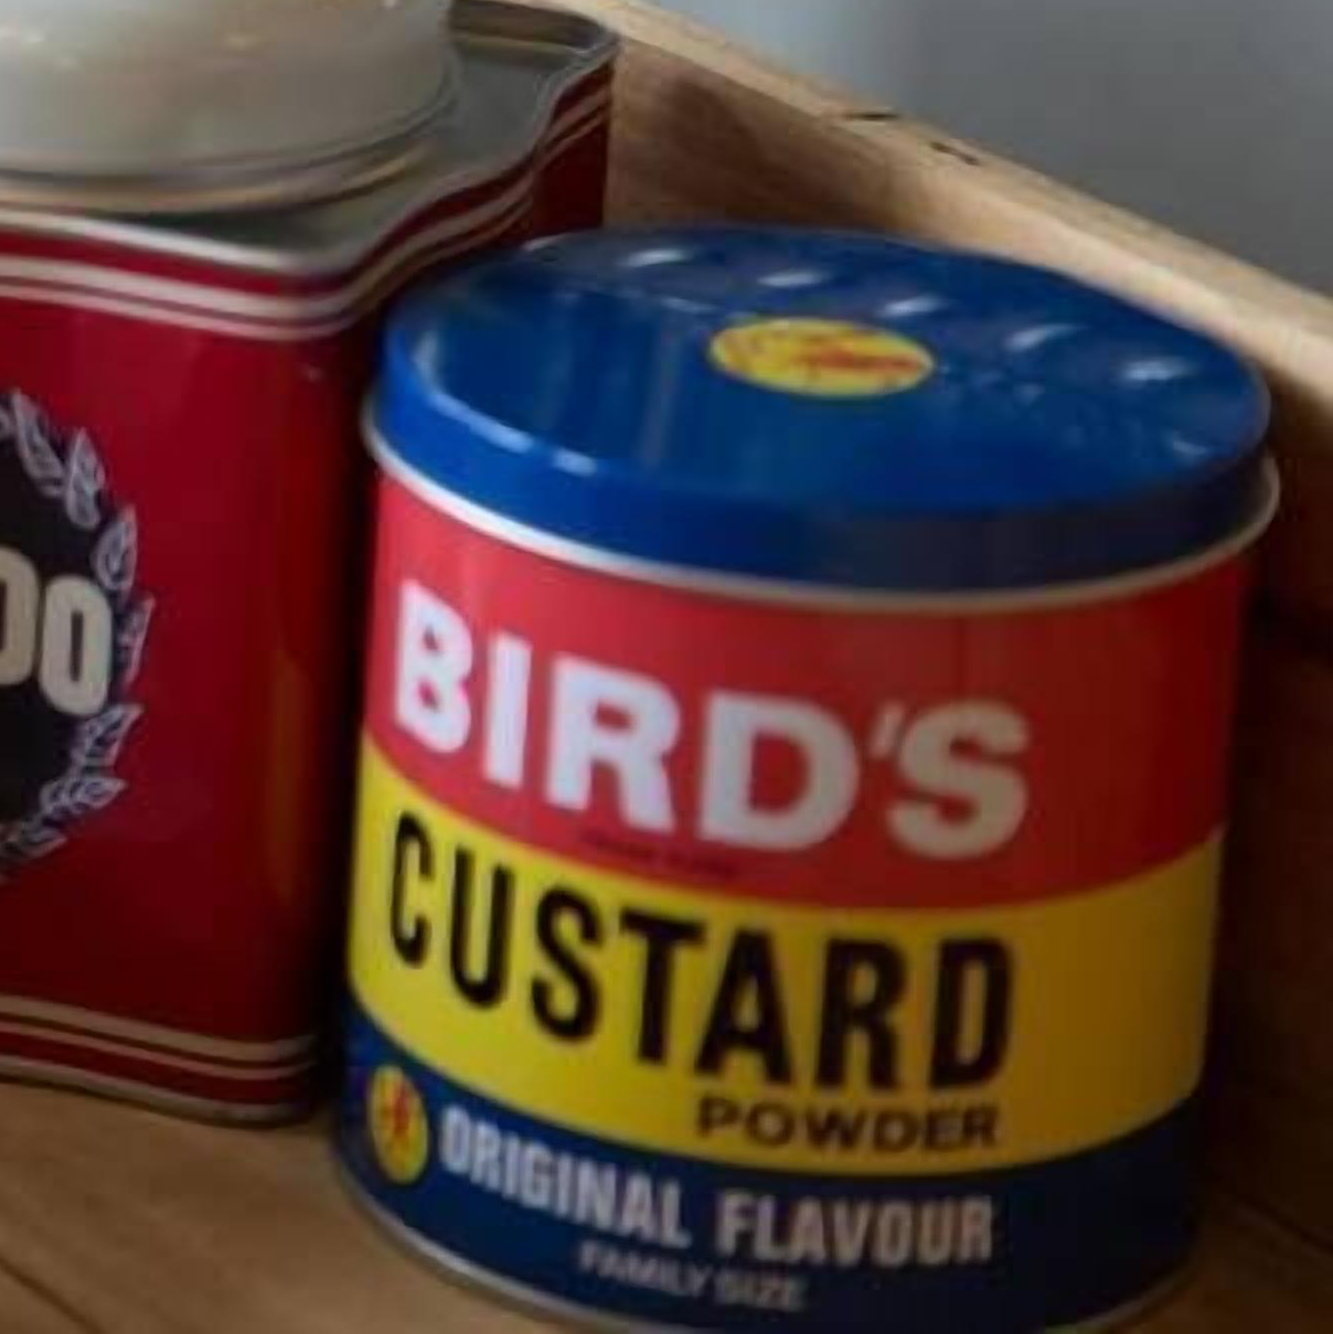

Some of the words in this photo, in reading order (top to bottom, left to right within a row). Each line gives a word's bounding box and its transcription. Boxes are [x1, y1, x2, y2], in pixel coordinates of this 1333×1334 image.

[393, 580, 1031, 859] BIRD'S
[389, 811, 1017, 1093] CUSTARD
[439, 1104, 693, 1250] ORIGINAL
[715, 1189, 995, 1266] FLAVOUR
[695, 1094, 1001, 1154] POWDER
[573, 1238, 714, 1298] FAMILY
[715, 1266, 807, 1312] SIZE
